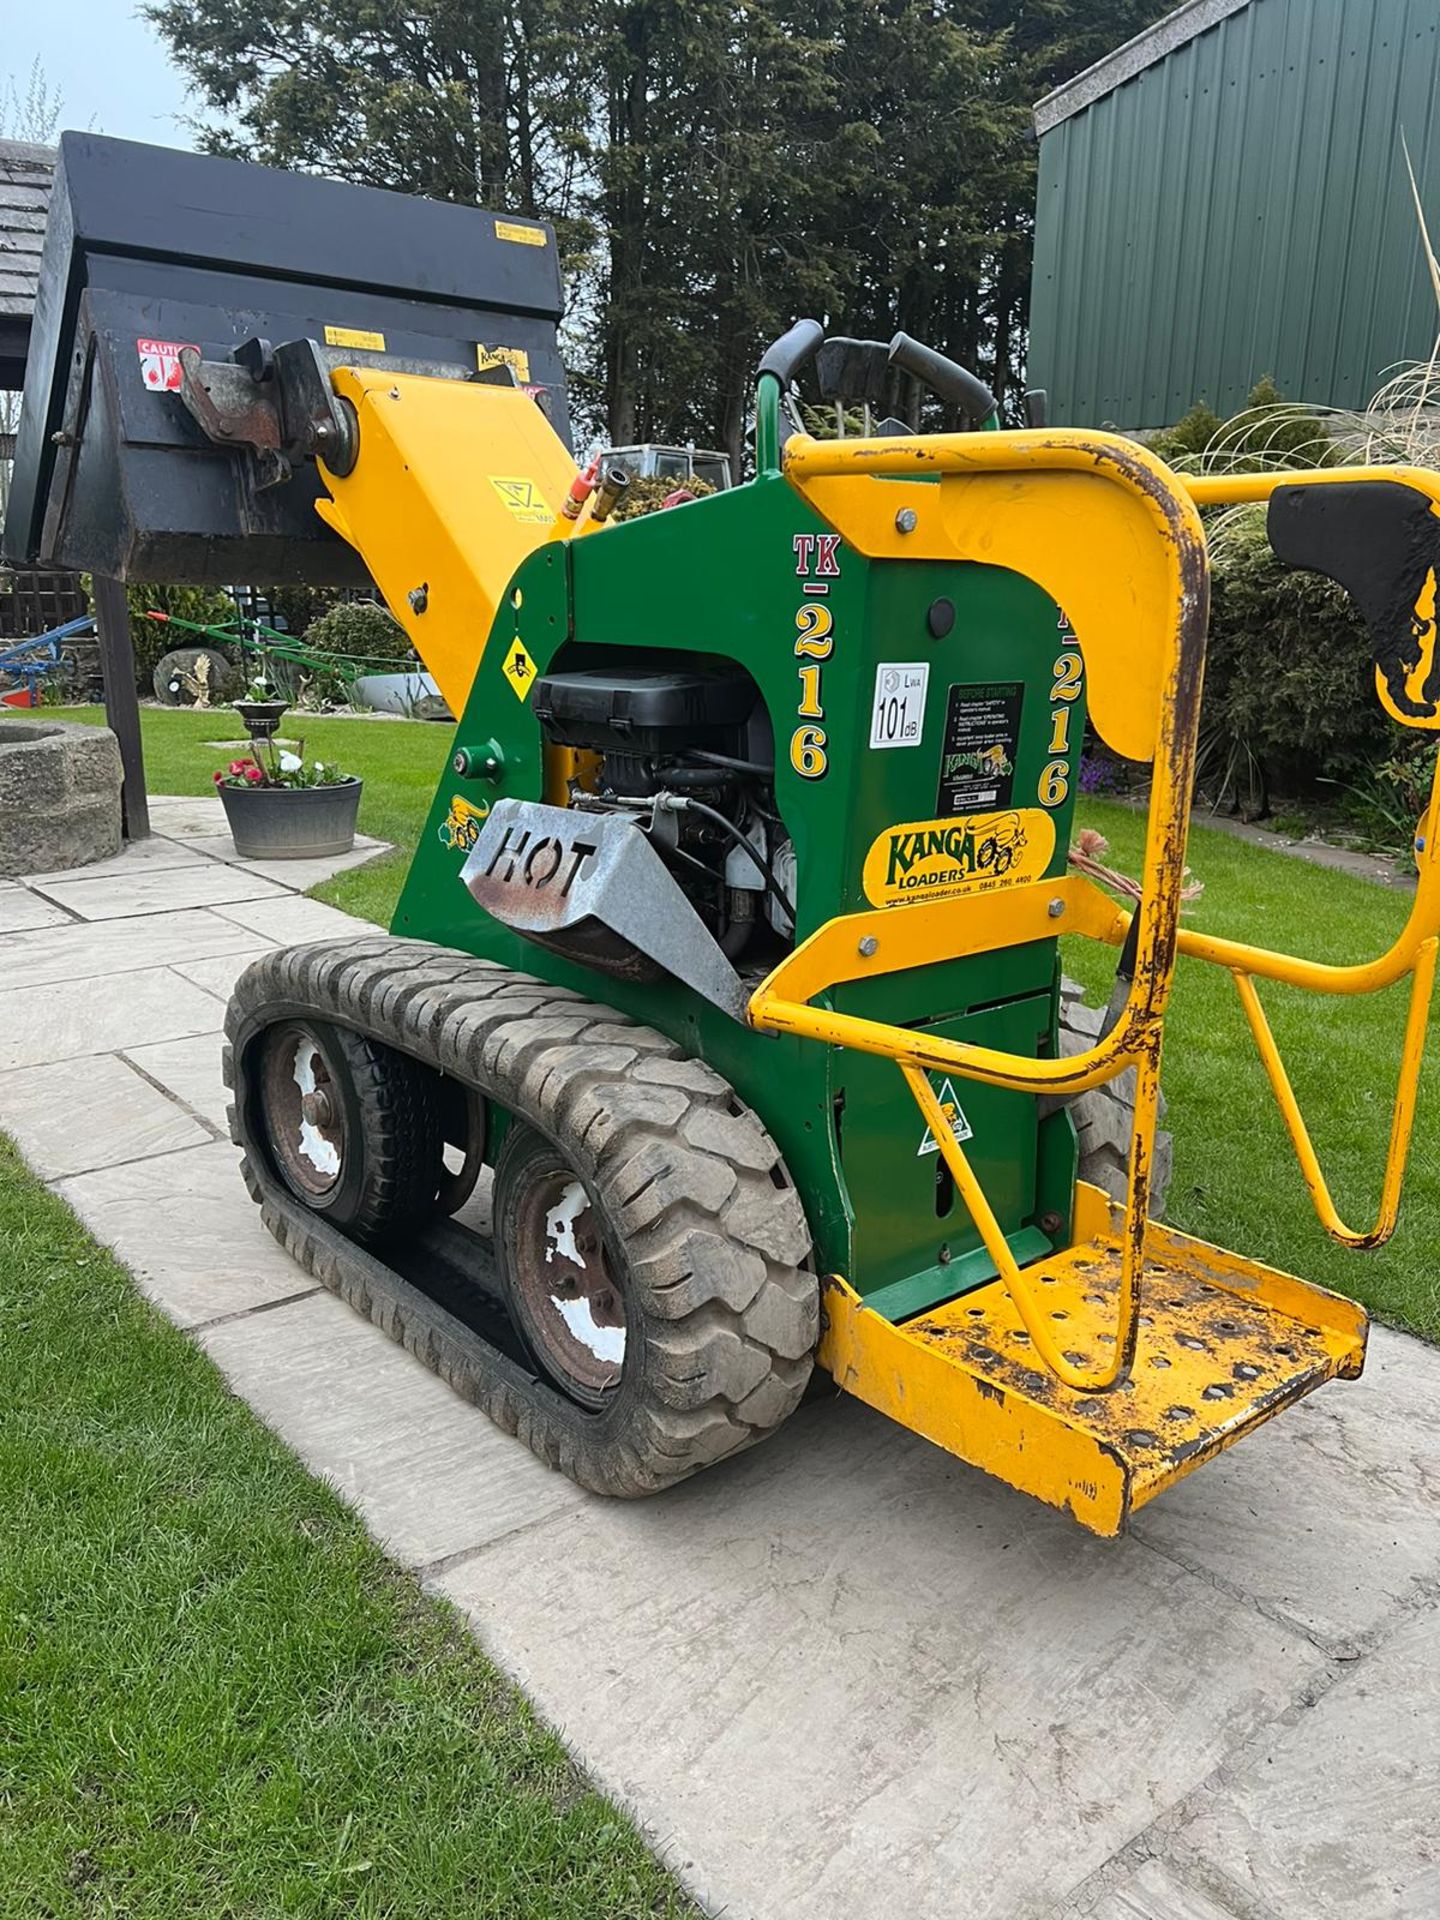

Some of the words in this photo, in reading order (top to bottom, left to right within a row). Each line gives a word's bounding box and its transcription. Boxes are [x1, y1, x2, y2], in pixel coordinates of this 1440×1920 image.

[141, 342, 189, 357] CAUTI
[879, 696, 907, 739] 101
[484, 826, 598, 898] HOT
[886, 827, 977, 886] KANGA
[898, 868, 966, 890] LOADERS
